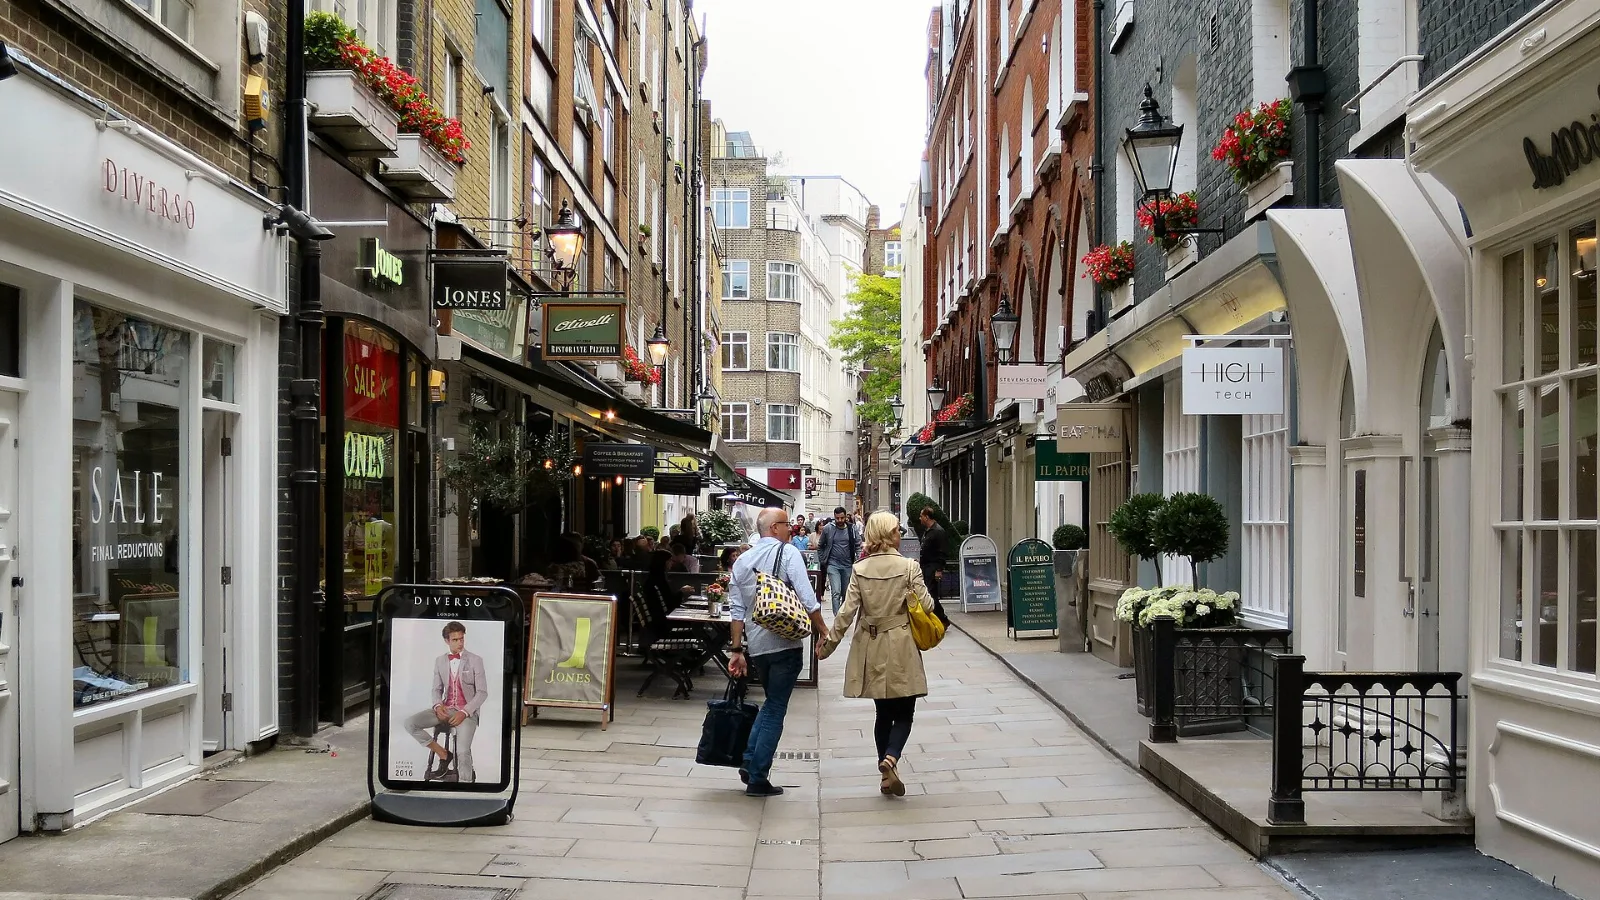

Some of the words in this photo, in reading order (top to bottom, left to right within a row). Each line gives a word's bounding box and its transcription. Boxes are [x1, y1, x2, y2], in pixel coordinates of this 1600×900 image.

[105, 158, 195, 230] DIVERSO
[371, 237, 403, 286] JONES
[436, 286, 502, 306] JONES
[554, 313, 616, 333] Olivelli
[551, 345, 588, 354] RISTORANTE
[589, 345, 617, 354] PIZZERIA
[354, 363, 376, 399] SALE
[1202, 362, 1264, 383] HIGH
[344, 431, 385, 479] ONES
[1040, 465, 1052, 476] IL
[91, 466, 163, 524] SALE
[92, 545, 114, 562] FINAL
[117, 542, 163, 559] REDUCTIONS
[1016, 555, 1024, 563] IL
[1024, 554, 1050, 563] PAPIRO
[414, 596, 483, 607] DIVERSO
[544, 669, 591, 684] JONES
[395, 769, 413, 777] 2016
